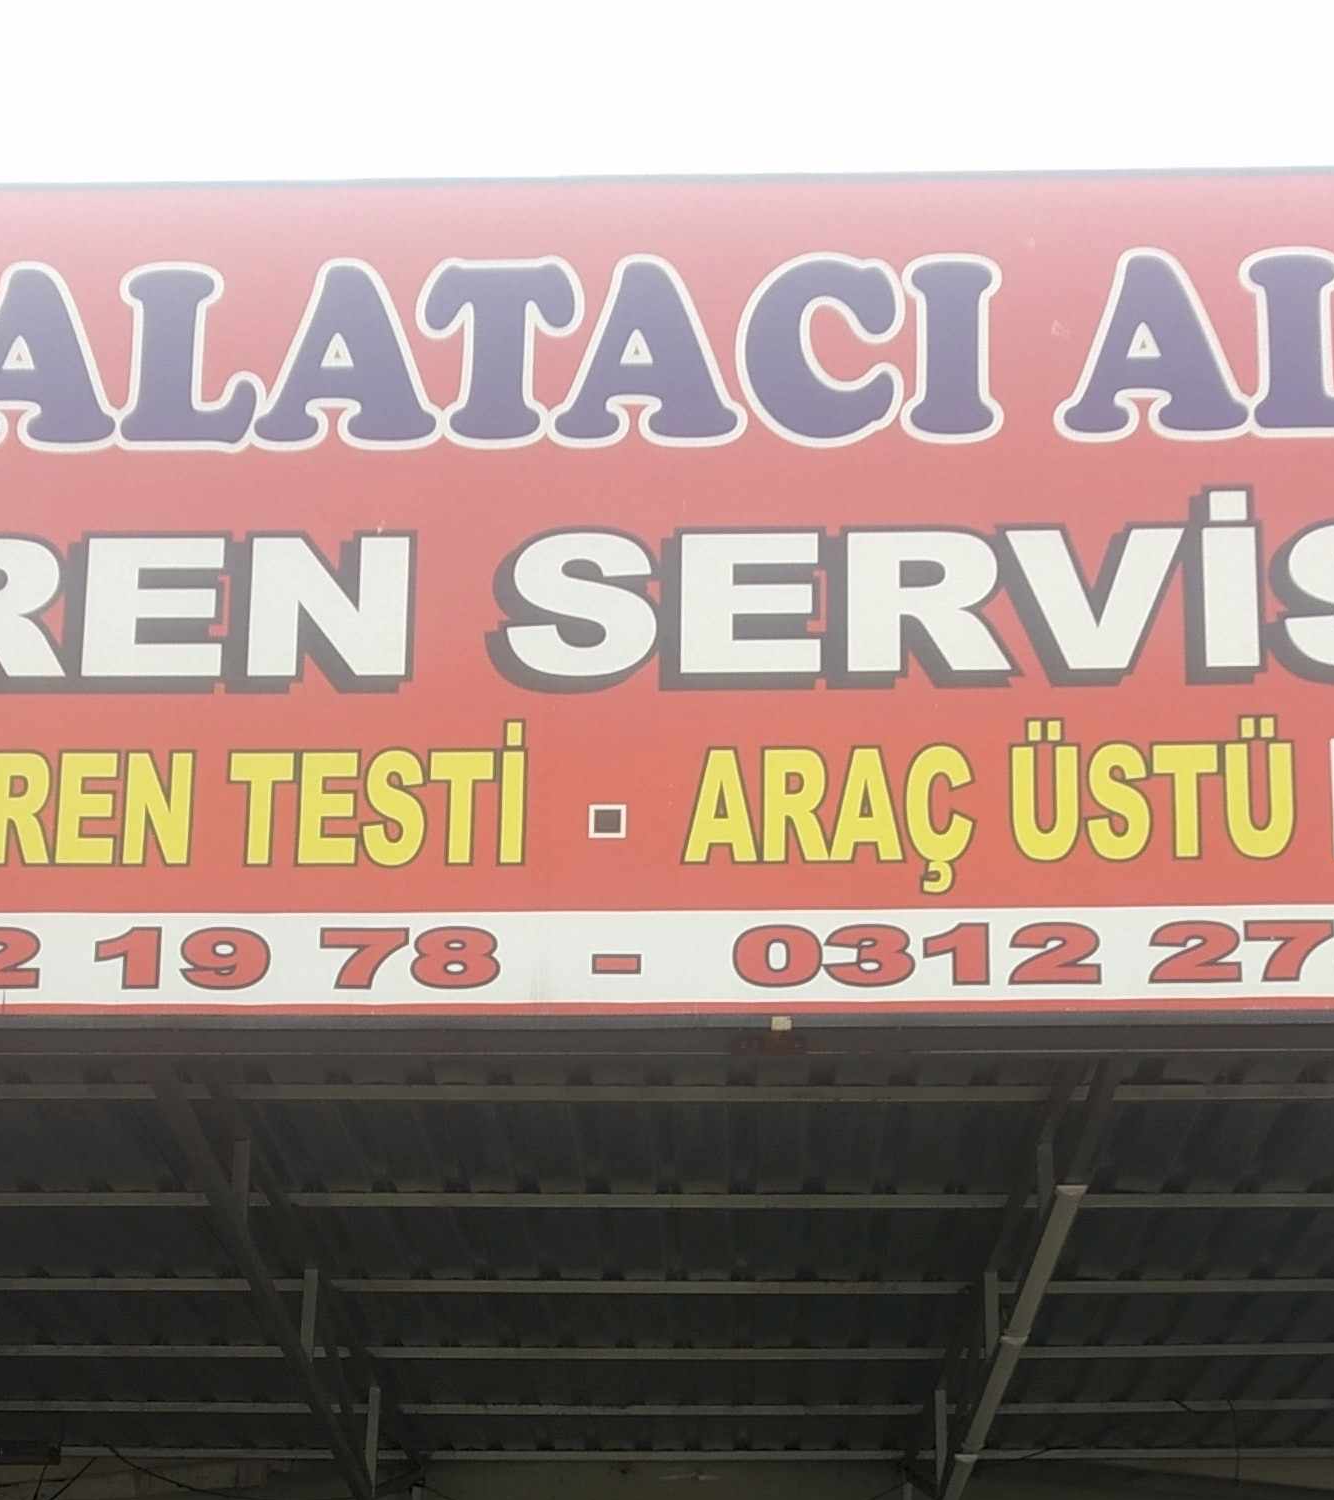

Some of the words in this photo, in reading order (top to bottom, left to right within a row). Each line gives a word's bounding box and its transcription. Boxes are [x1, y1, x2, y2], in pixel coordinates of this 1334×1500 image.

[229, 719, 528, 868] TESTİ
[681, 742, 976, 894] ARAÇ
[1008, 715, 1295, 861] ÜSTÜ
[94, 926, 271, 990] 19
[320, 925, 501, 989] 78
[591, 953, 642, 975] -
[733, 921, 1102, 986] 0312
